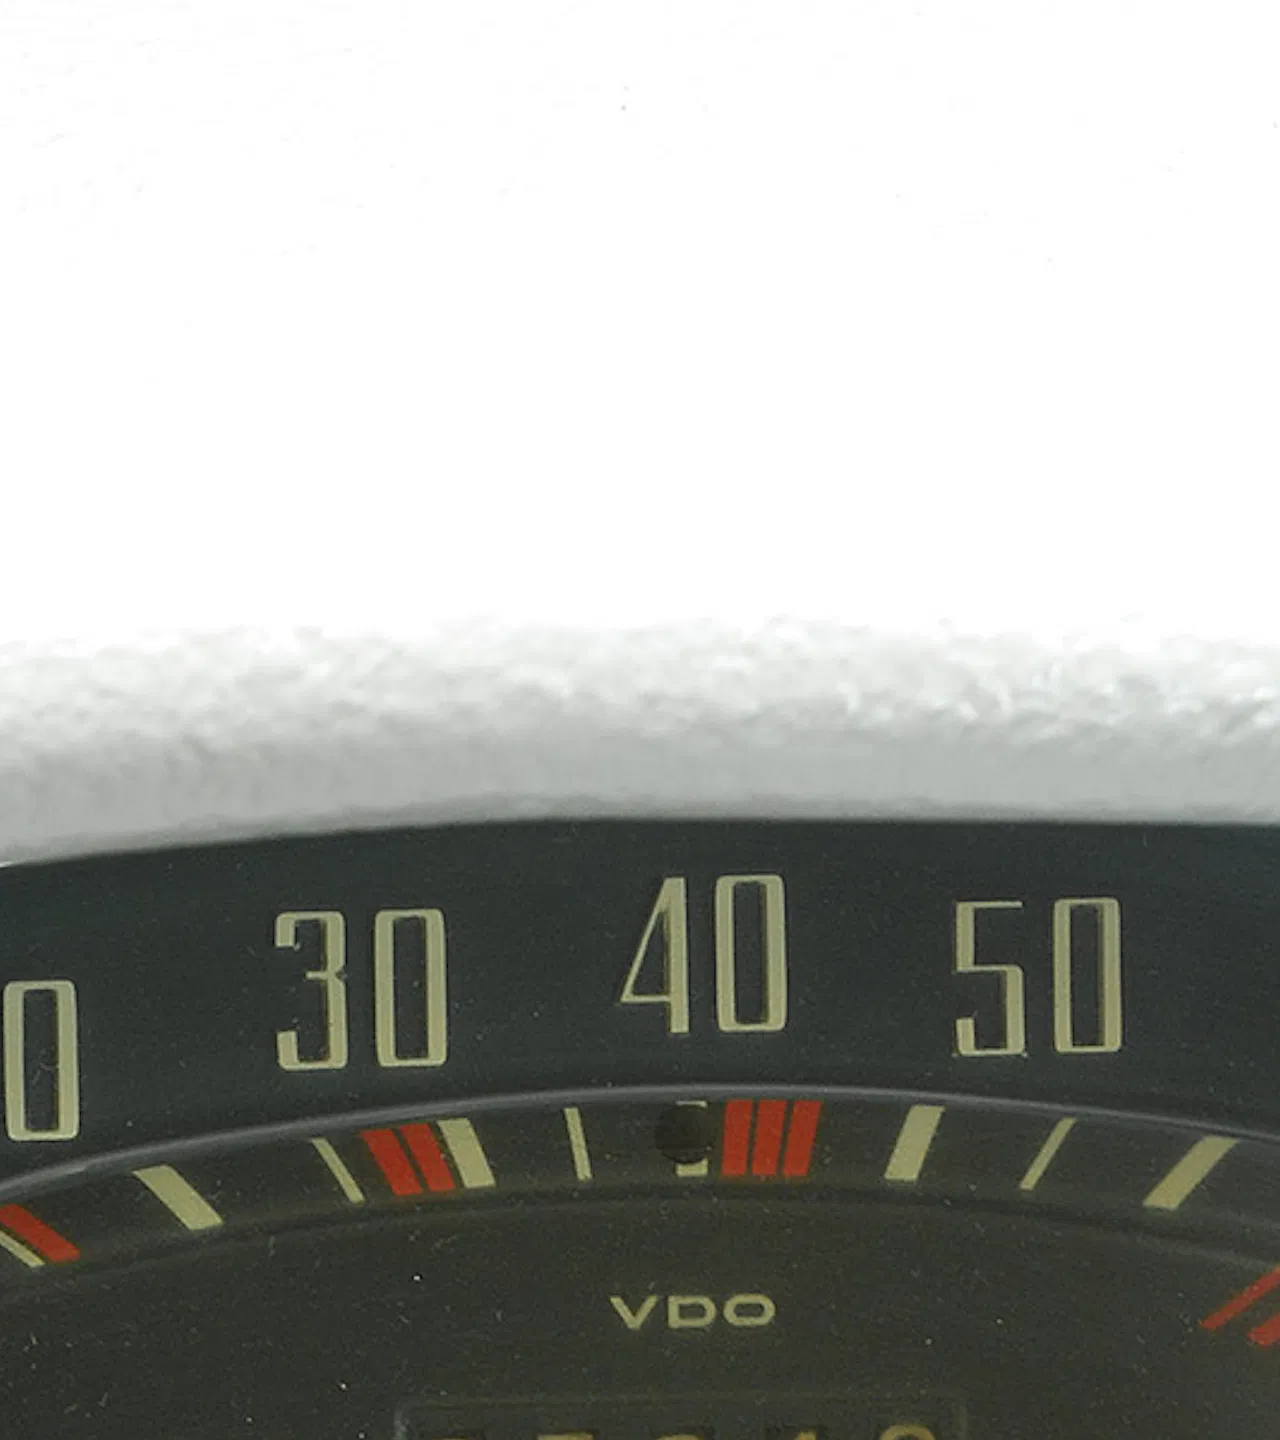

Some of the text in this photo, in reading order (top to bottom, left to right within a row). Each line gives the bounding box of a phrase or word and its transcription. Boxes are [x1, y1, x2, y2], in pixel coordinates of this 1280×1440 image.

[275, 908, 448, 1071] 30
[619, 874, 788, 1034] 40
[955, 897, 1122, 1058] 50
[609, 1292, 776, 1331] VDO
